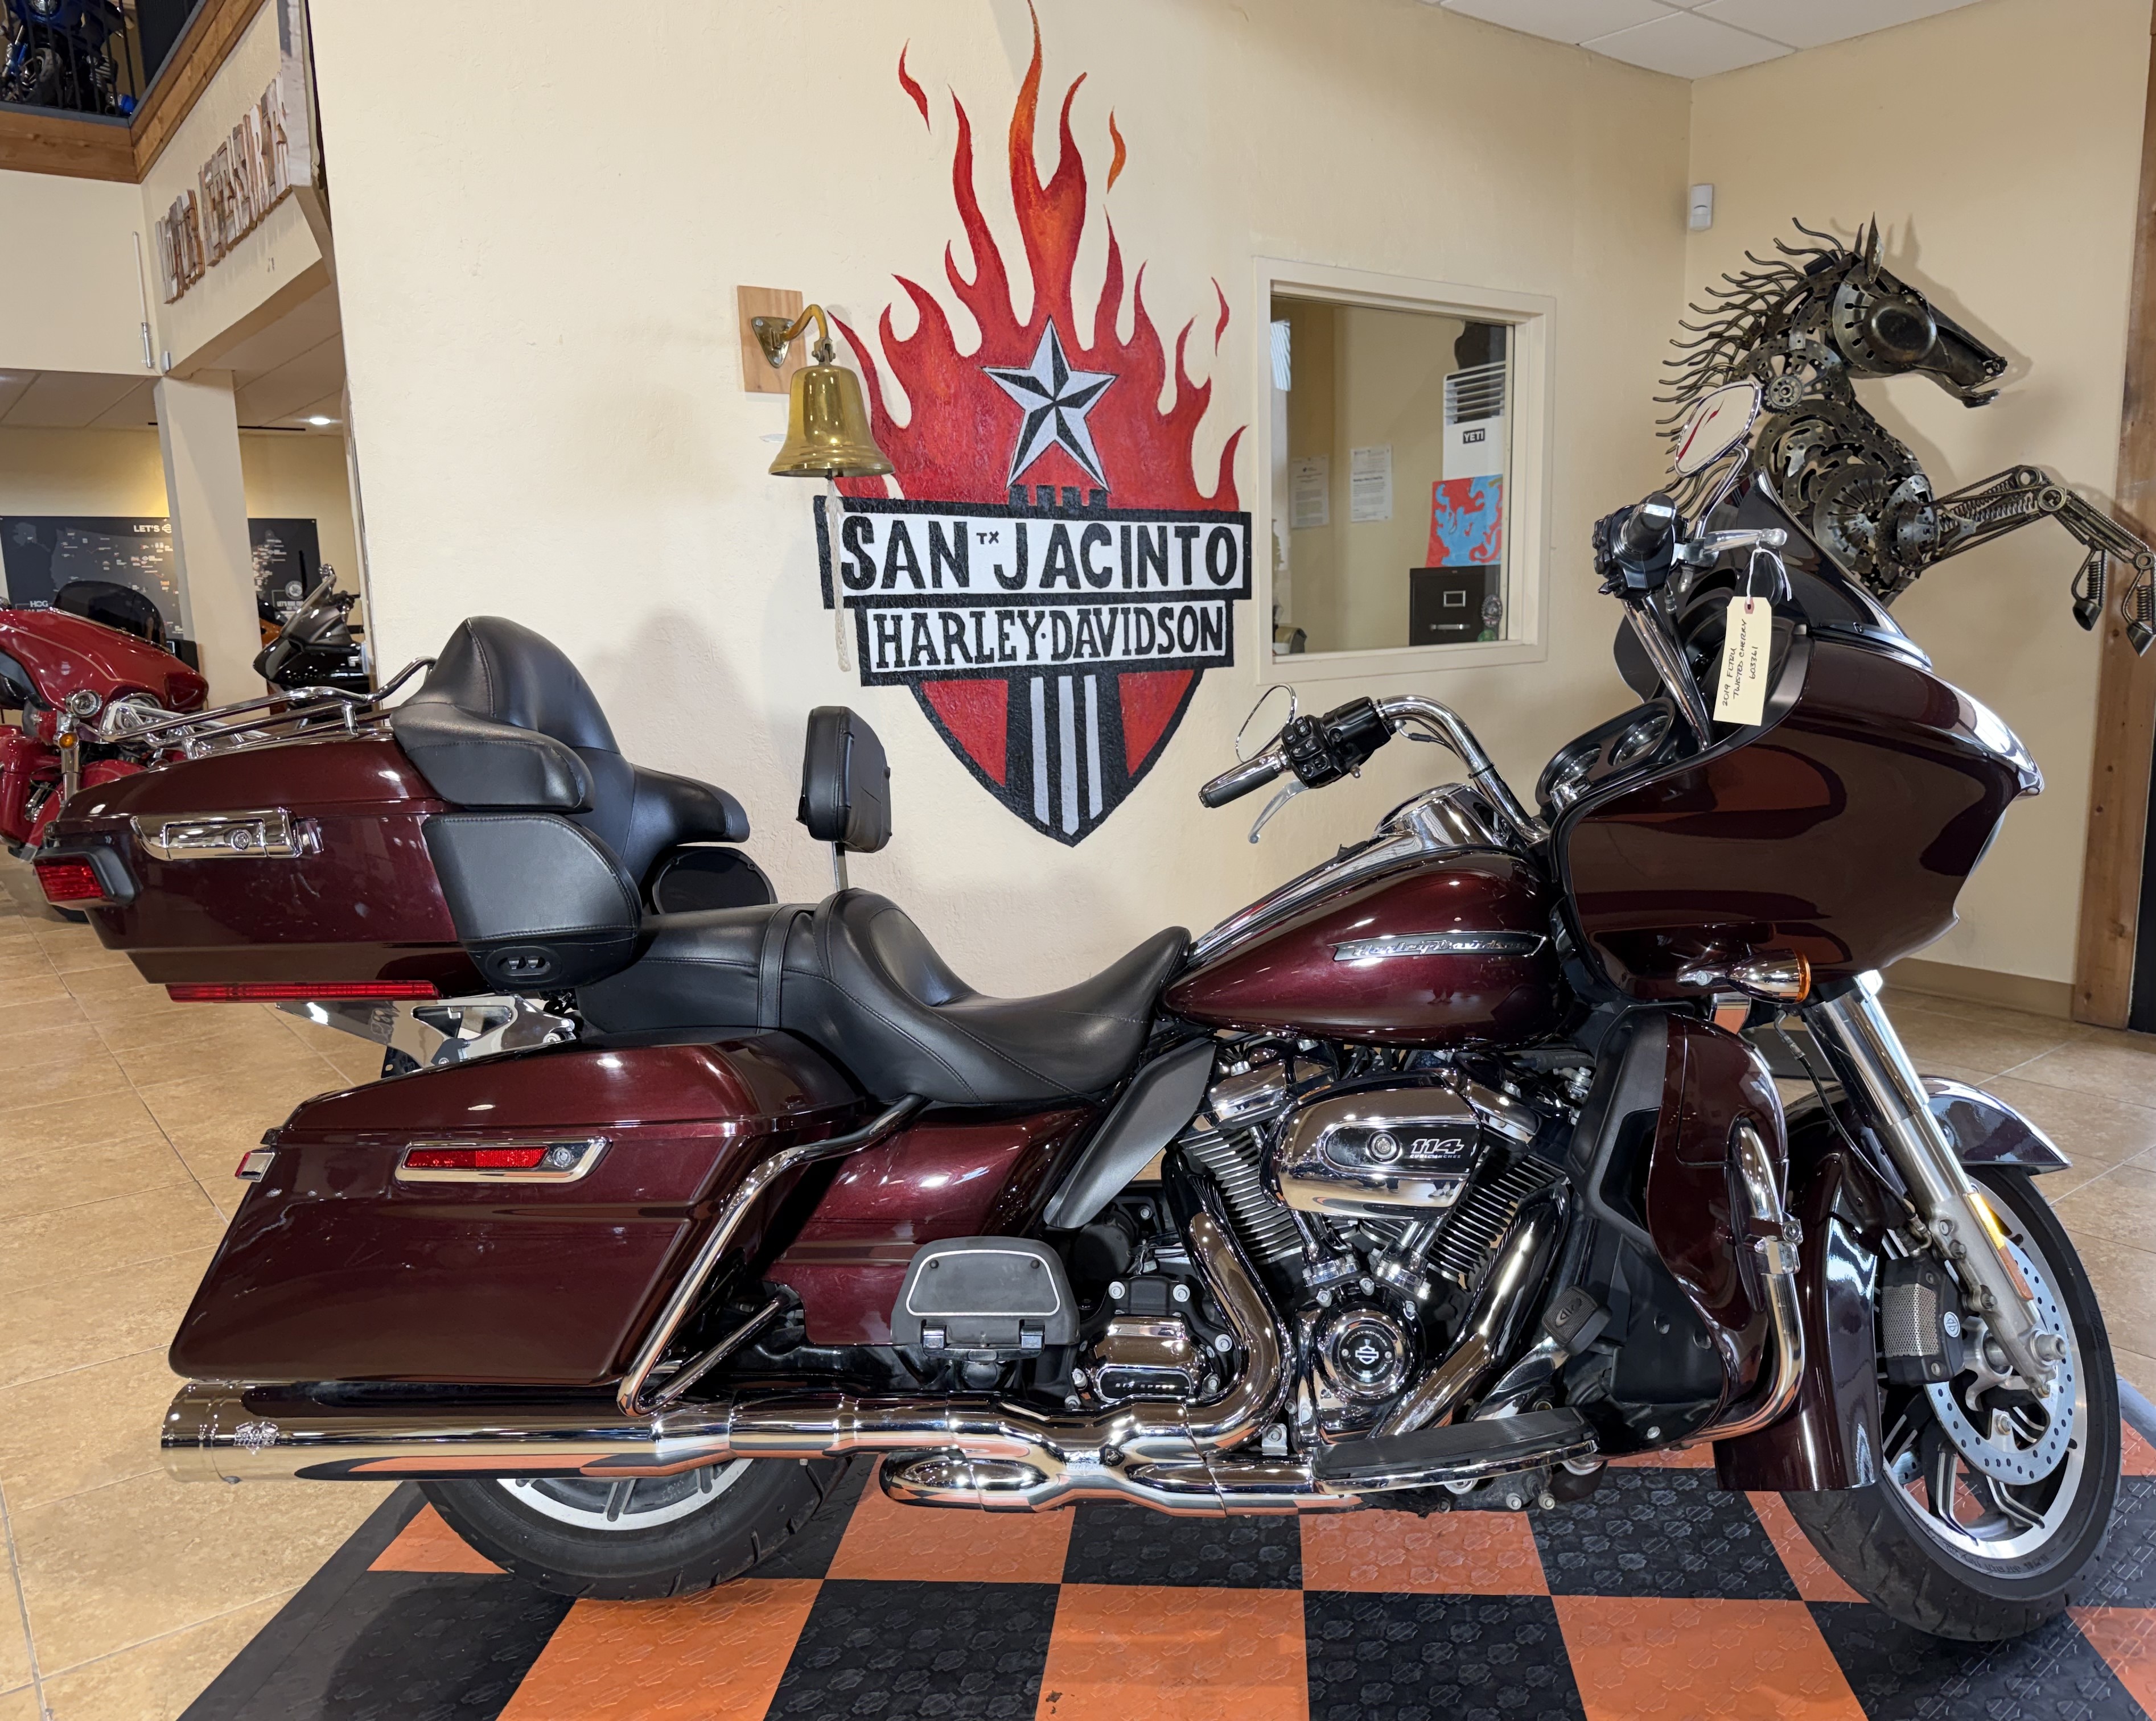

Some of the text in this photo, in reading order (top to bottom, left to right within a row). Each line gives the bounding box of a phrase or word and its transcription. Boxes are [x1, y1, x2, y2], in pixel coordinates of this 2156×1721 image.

[1464, 430, 1484, 442] YETI
[841, 515, 1239, 591] SAN TX JACINTO
[1727, 648, 1737, 678] FLTRU
[1749, 646, 1758, 680] 603361
[1733, 661, 1743, 699] TWISTED
[1410, 1138, 1464, 1154] 114
